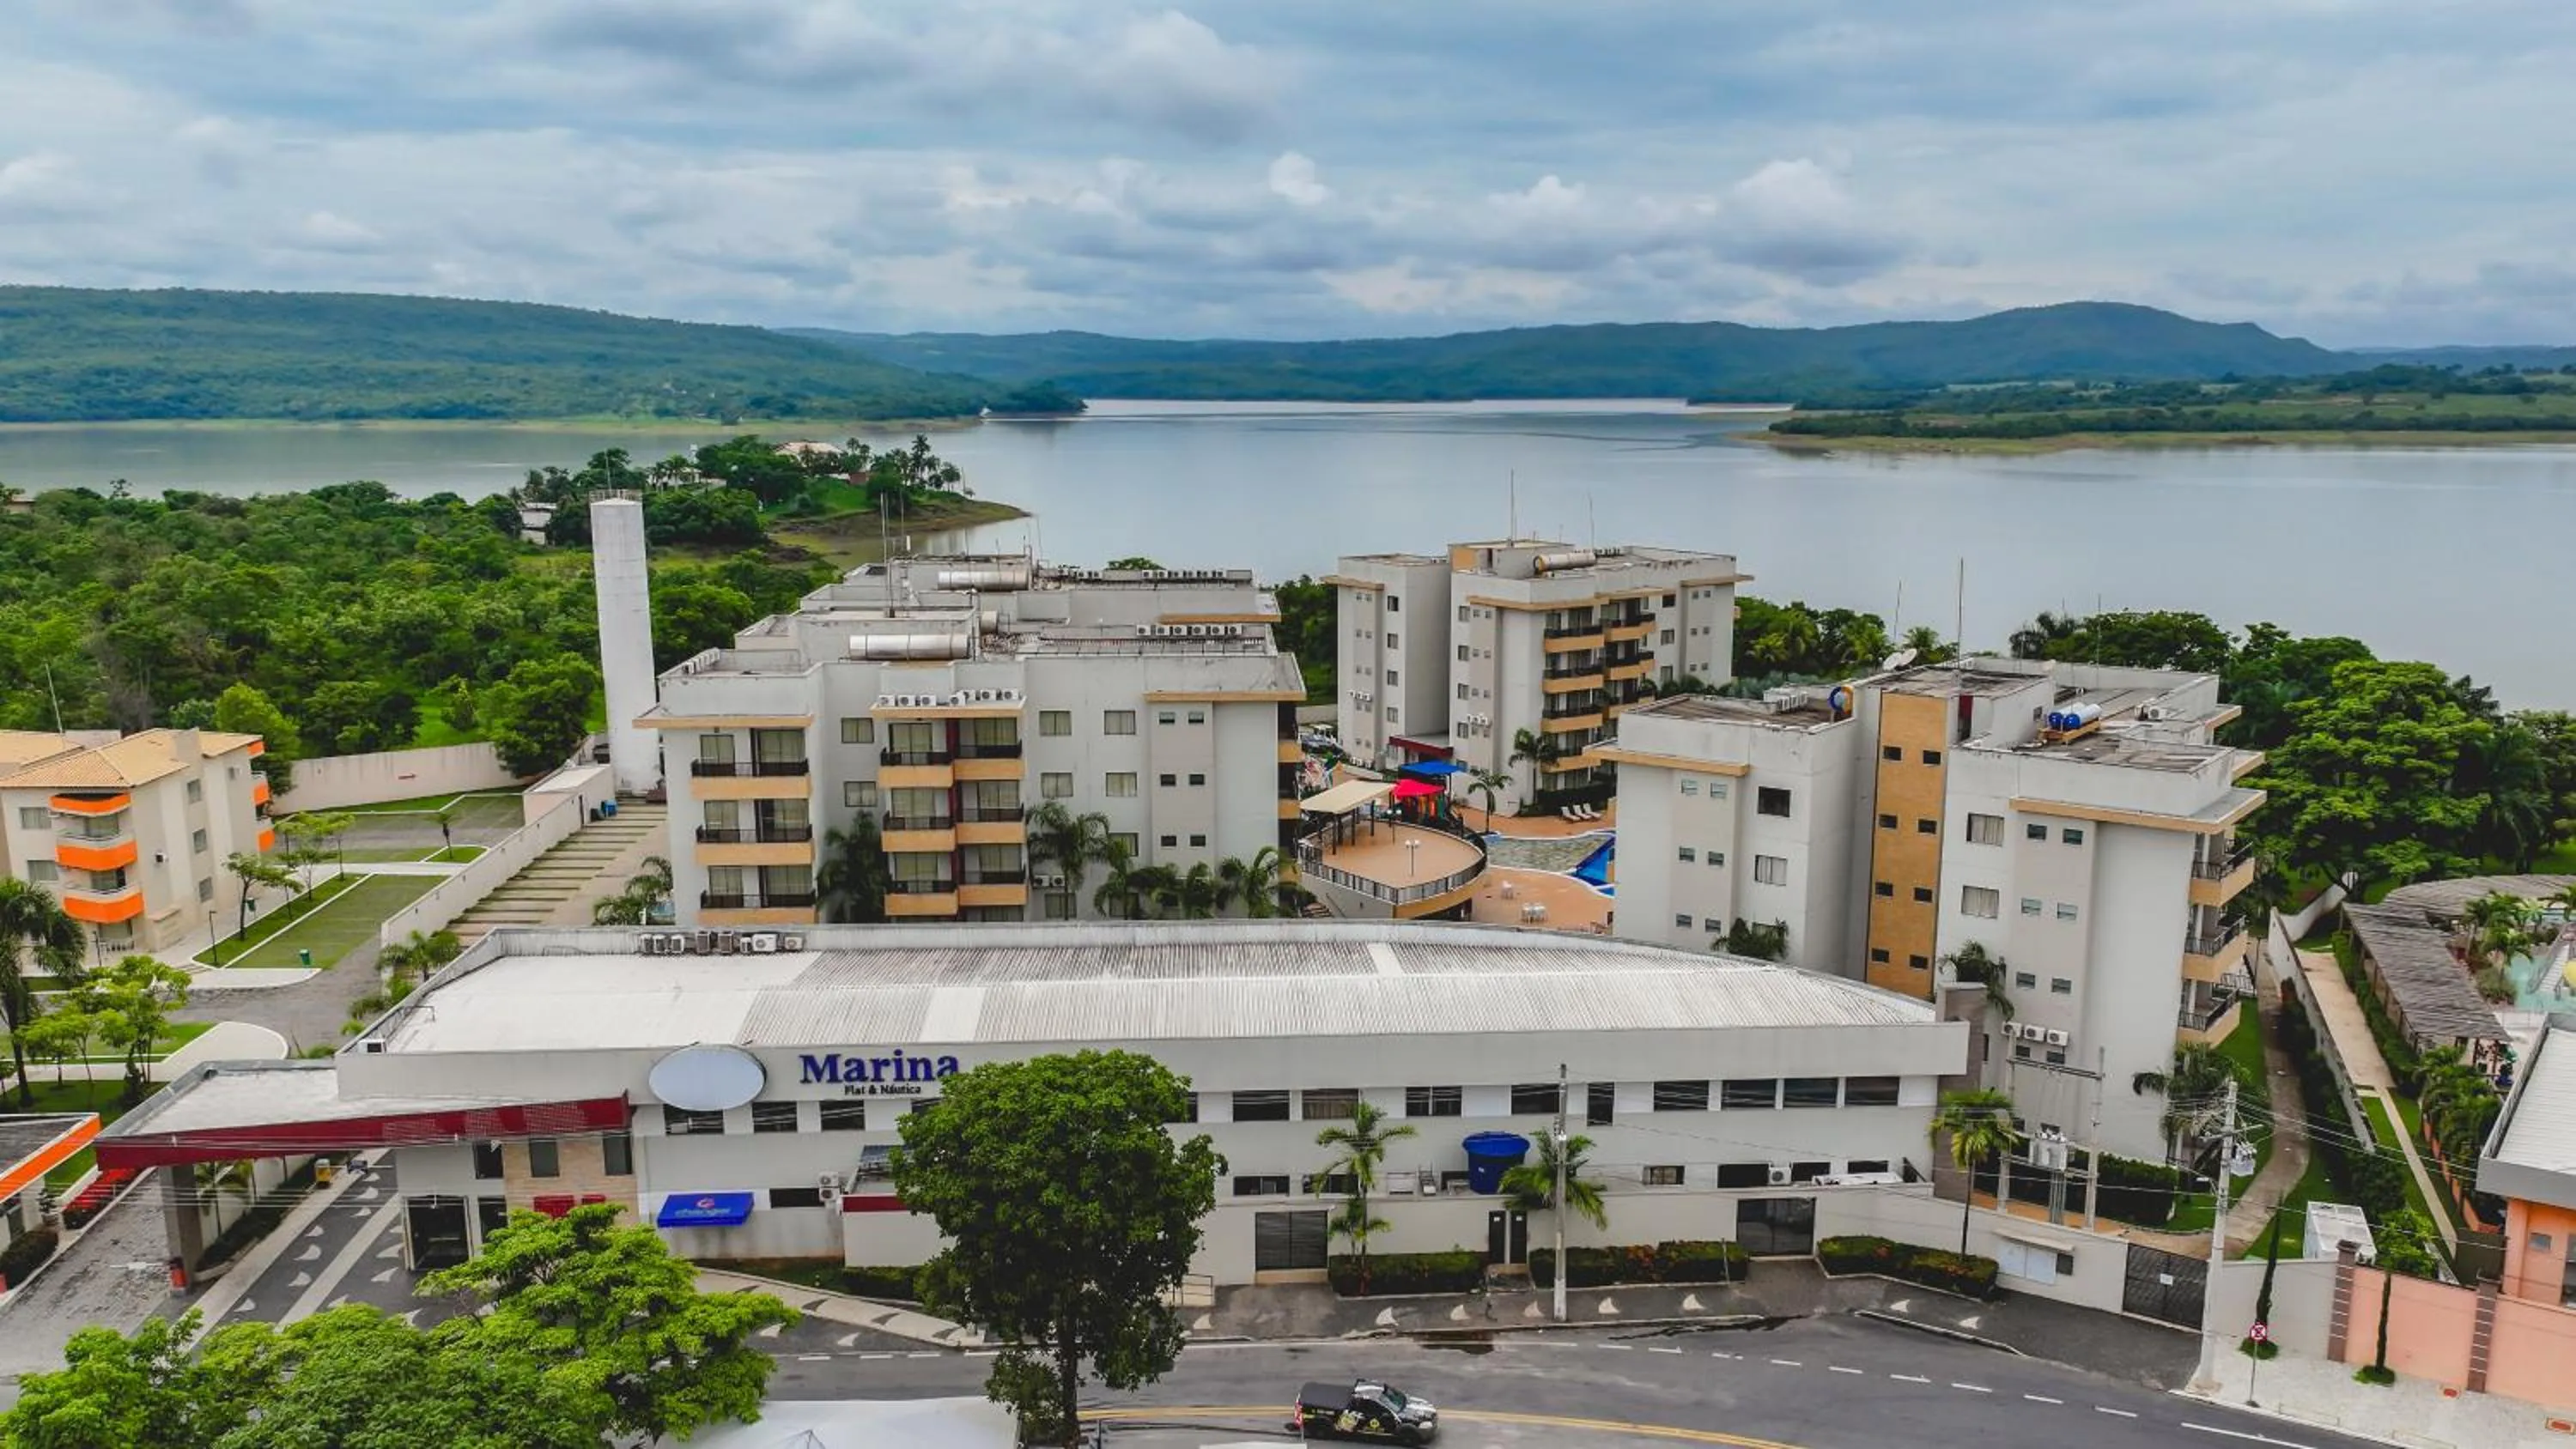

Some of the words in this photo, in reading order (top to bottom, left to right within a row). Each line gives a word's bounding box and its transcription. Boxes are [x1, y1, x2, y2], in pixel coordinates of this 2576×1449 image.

[799, 1049, 959, 1084] Marina
[844, 1085, 865, 1095] Flat
[868, 1085, 877, 1094] &
[880, 1083, 921, 1094] Náutica
